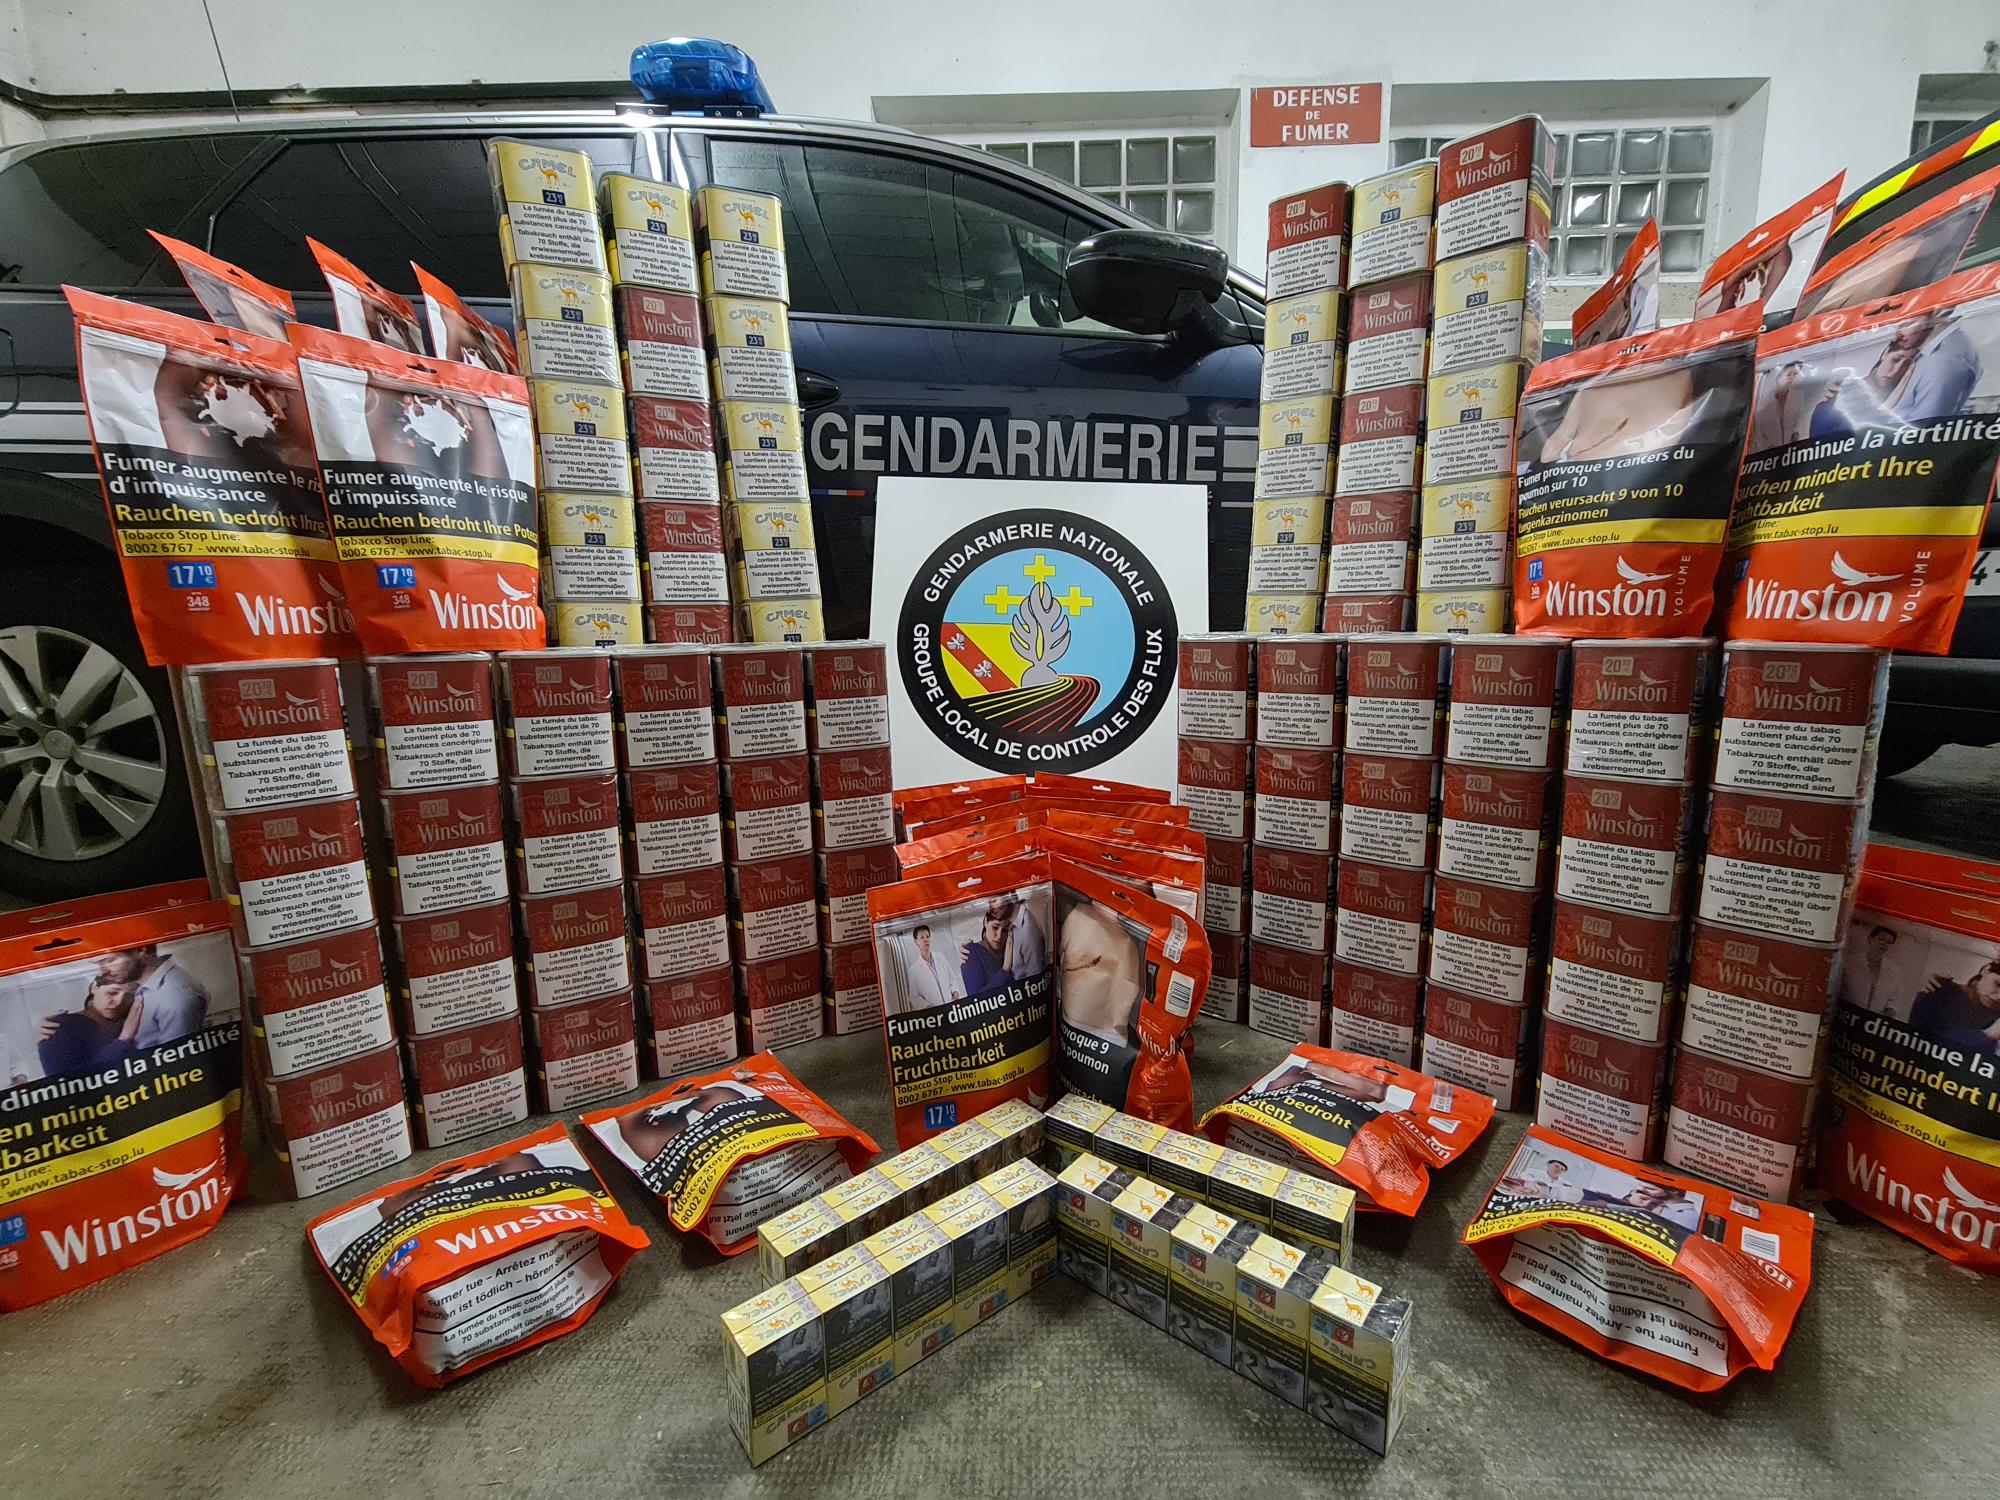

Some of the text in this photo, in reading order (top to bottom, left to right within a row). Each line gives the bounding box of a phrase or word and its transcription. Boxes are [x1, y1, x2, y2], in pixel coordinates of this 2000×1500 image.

[1273, 86, 1360, 107] DEFENSE
[1306, 111, 1320, 120] DE
[1282, 123, 1349, 142] FUMER
[519, 159, 576, 178] CAMEL
[1456, 159, 1510, 188] Winston
[627, 190, 678, 210] CAMEL
[722, 203, 769, 219] CAMEL
[1282, 215, 1328, 238] Winston
[642, 315, 691, 338] Winston
[1444, 378, 1497, 397] CAMEL
[553, 393, 608, 410] CAMEL
[810, 412, 1218, 482] GENDARMERIE
[1781, 417, 2000, 466] diminue la fertilité
[103, 453, 176, 475] Fumer
[182, 464, 287, 485] augmente
[290, 471, 304, 487] le
[1518, 446, 1695, 488] Fumer provoque 9 cancers du
[1793, 460, 1872, 490] mindert
[1878, 455, 1933, 477] Ihre
[110, 476, 266, 502] d'impuissance
[323, 469, 384, 485] Fumer
[390, 471, 471, 493] augmente
[474, 481, 486, 495] le
[491, 486, 528, 502] risque
[329, 490, 456, 508] d'impuissance
[1519, 476, 1588, 504] poumon sur 10
[1550, 492, 1615, 510] verursacht
[1618, 488, 1628, 500] 9
[1631, 487, 1658, 499] von
[1664, 483, 1683, 497] 10
[115, 504, 325, 533] Rauchen bedroht Ihre
[333, 514, 414, 529] Rauchen
[418, 512, 481, 532] bedroht
[484, 521, 511, 536] Ihre
[123, 530, 241, 542] Tobacco Stop Line:
[339, 536, 435, 546] Tobacco Stop Line:
[1533, 532, 1546, 541] Stop
[1548, 528, 1564, 537] Line:
[1541, 532, 1620, 549] www.tabac-stop.lu
[125, 543, 310, 558] 8002 6767 www.tabac-stop.lu
[341, 547, 492, 559] 8002 6767 www.tabac-stop.lu
[924, 522, 1154, 606] GENDARMERIE NATIONALE
[1545, 580, 1667, 617] Winston
[1673, 555, 1691, 616] VOLUME
[1899, 550, 1932, 622] VOLUME
[429, 588, 537, 631] Winston
[1746, 577, 1893, 622] Winston
[913, 623, 1163, 761] GROUPE LOCAL DE CONTROLE DES FLUX
[1365, 671, 1418, 690] Winston
[1754, 686, 1842, 712] Winston
[236, 704, 320, 728] Winston
[238, 748, 279, 757] contient
[282, 744, 301, 753] plus
[252, 738, 283, 747] fumée
[223, 749, 344, 767] substances cancérigènes
[228, 768, 286, 779] Tabakrauch
[289, 763, 321, 772] enthält
[248, 779, 333, 794] erwiesenermaßen
[272, 774, 304, 782] Stoffe,
[245, 791, 315, 803] krebserregend
[888, 986, 1023, 1037] Fumer diminue la
[891, 1004, 1047, 1062] Rauchen mindert Ihre
[1067, 1047, 1109, 1074] poumon
[1100, 1042, 1109, 1054] 9
[1864, 1017, 1964, 1067] diminue
[1970, 1052, 1993, 1079] la
[1, 1026, 241, 1112] diminue la fertilité
[893, 1042, 1006, 1082] Fruchtbarkeit
[897, 1071, 977, 1094] Tobacco Stop Line:
[897, 1067, 1025, 1105] 8002 6767 www.tabac-stop.lu
[1882, 1054, 1981, 1106] mindert
[42, 1084, 150, 1132] mindert
[154, 1067, 205, 1097] Ihre
[1283, 1096, 1353, 1129] bedroht
[721, 1112, 789, 1134] bedroht
[692, 1130, 750, 1171] Potenz
[725, 1128, 814, 1162] www.tabac-stop.lu
[8, 1145, 145, 1198] www.tabac-stop.lu
[14, 1164, 52, 1182] Line:
[499, 1167, 574, 1185] le risque
[507, 1187, 546, 1200] Ihre
[41, 1176, 219, 1271] Winston
[459, 1264, 554, 1312] ist tödlich hören
[466, 1257, 536, 1292] tue Arrêtez
[444, 1301, 522, 1342] La fumée du tabac
[461, 1312, 522, 1344] 70 substances
[1609, 1304, 1725, 1351] Rauchen ist tödlich
[1635, 1325, 1699, 1356] Fumer tue
